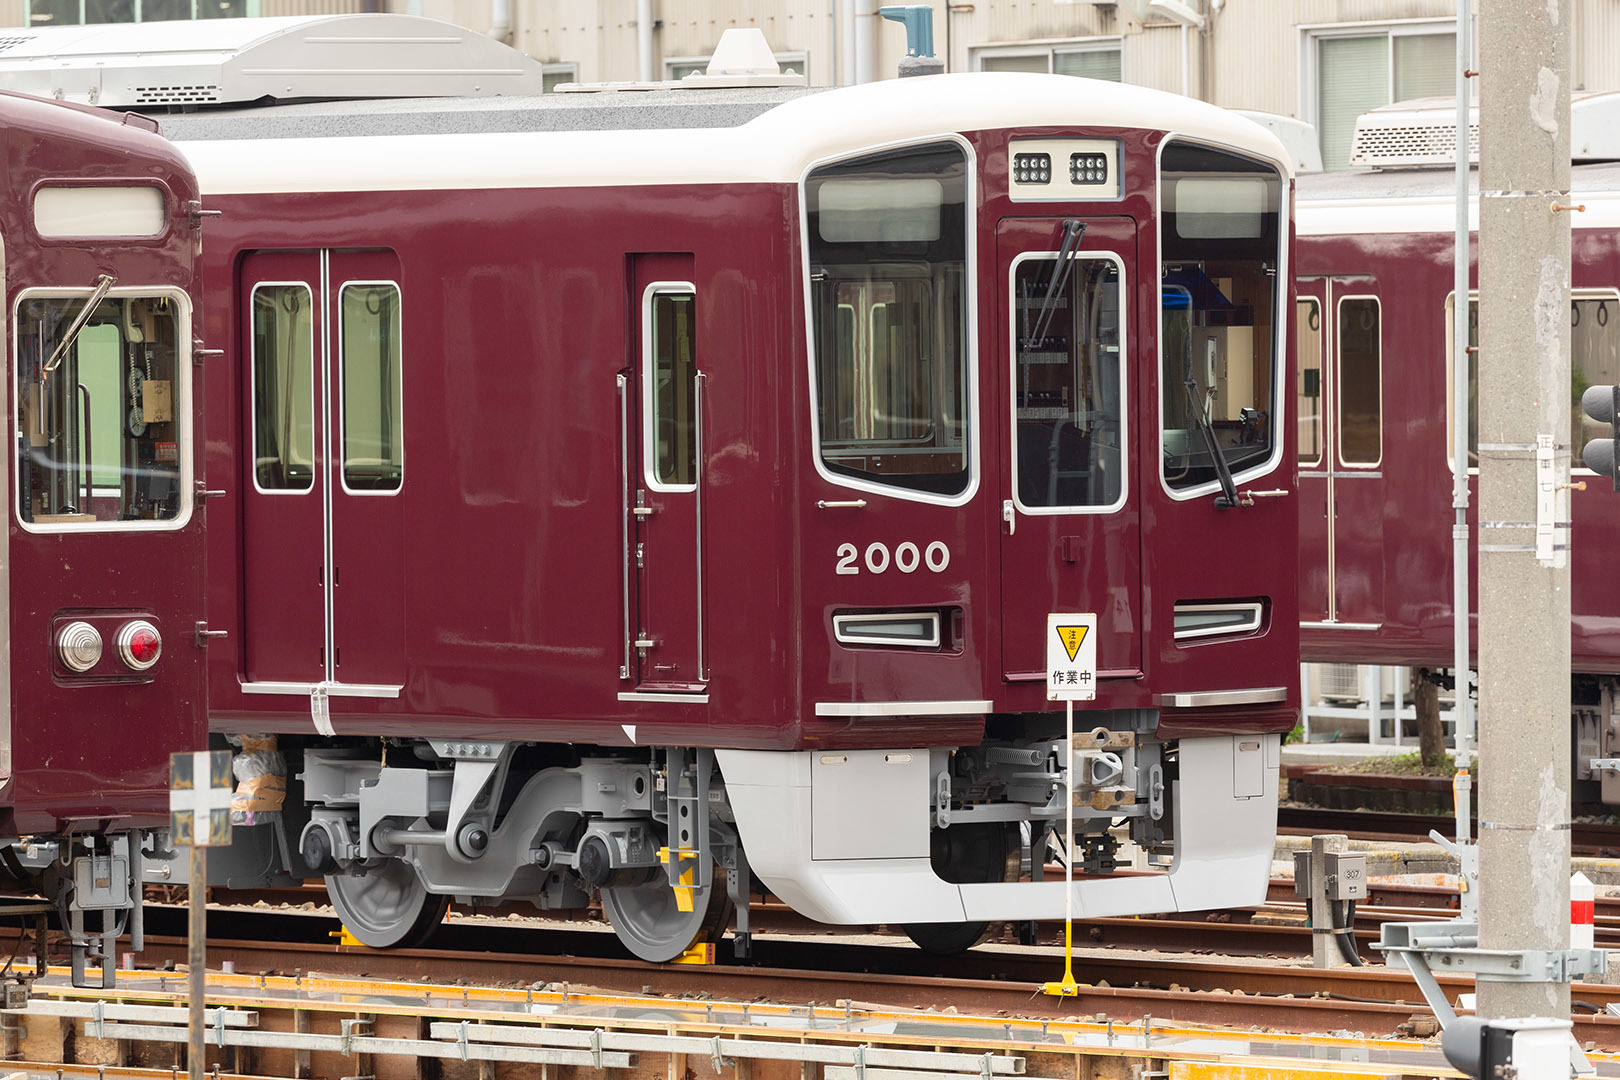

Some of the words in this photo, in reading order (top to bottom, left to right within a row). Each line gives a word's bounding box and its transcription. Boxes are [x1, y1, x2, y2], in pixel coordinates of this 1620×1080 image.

[836, 541, 950, 575] 2000
[1068, 629, 1077, 651] 注意
[1052, 669, 1092, 685] 作業中
[1346, 870, 1360, 879] 307
